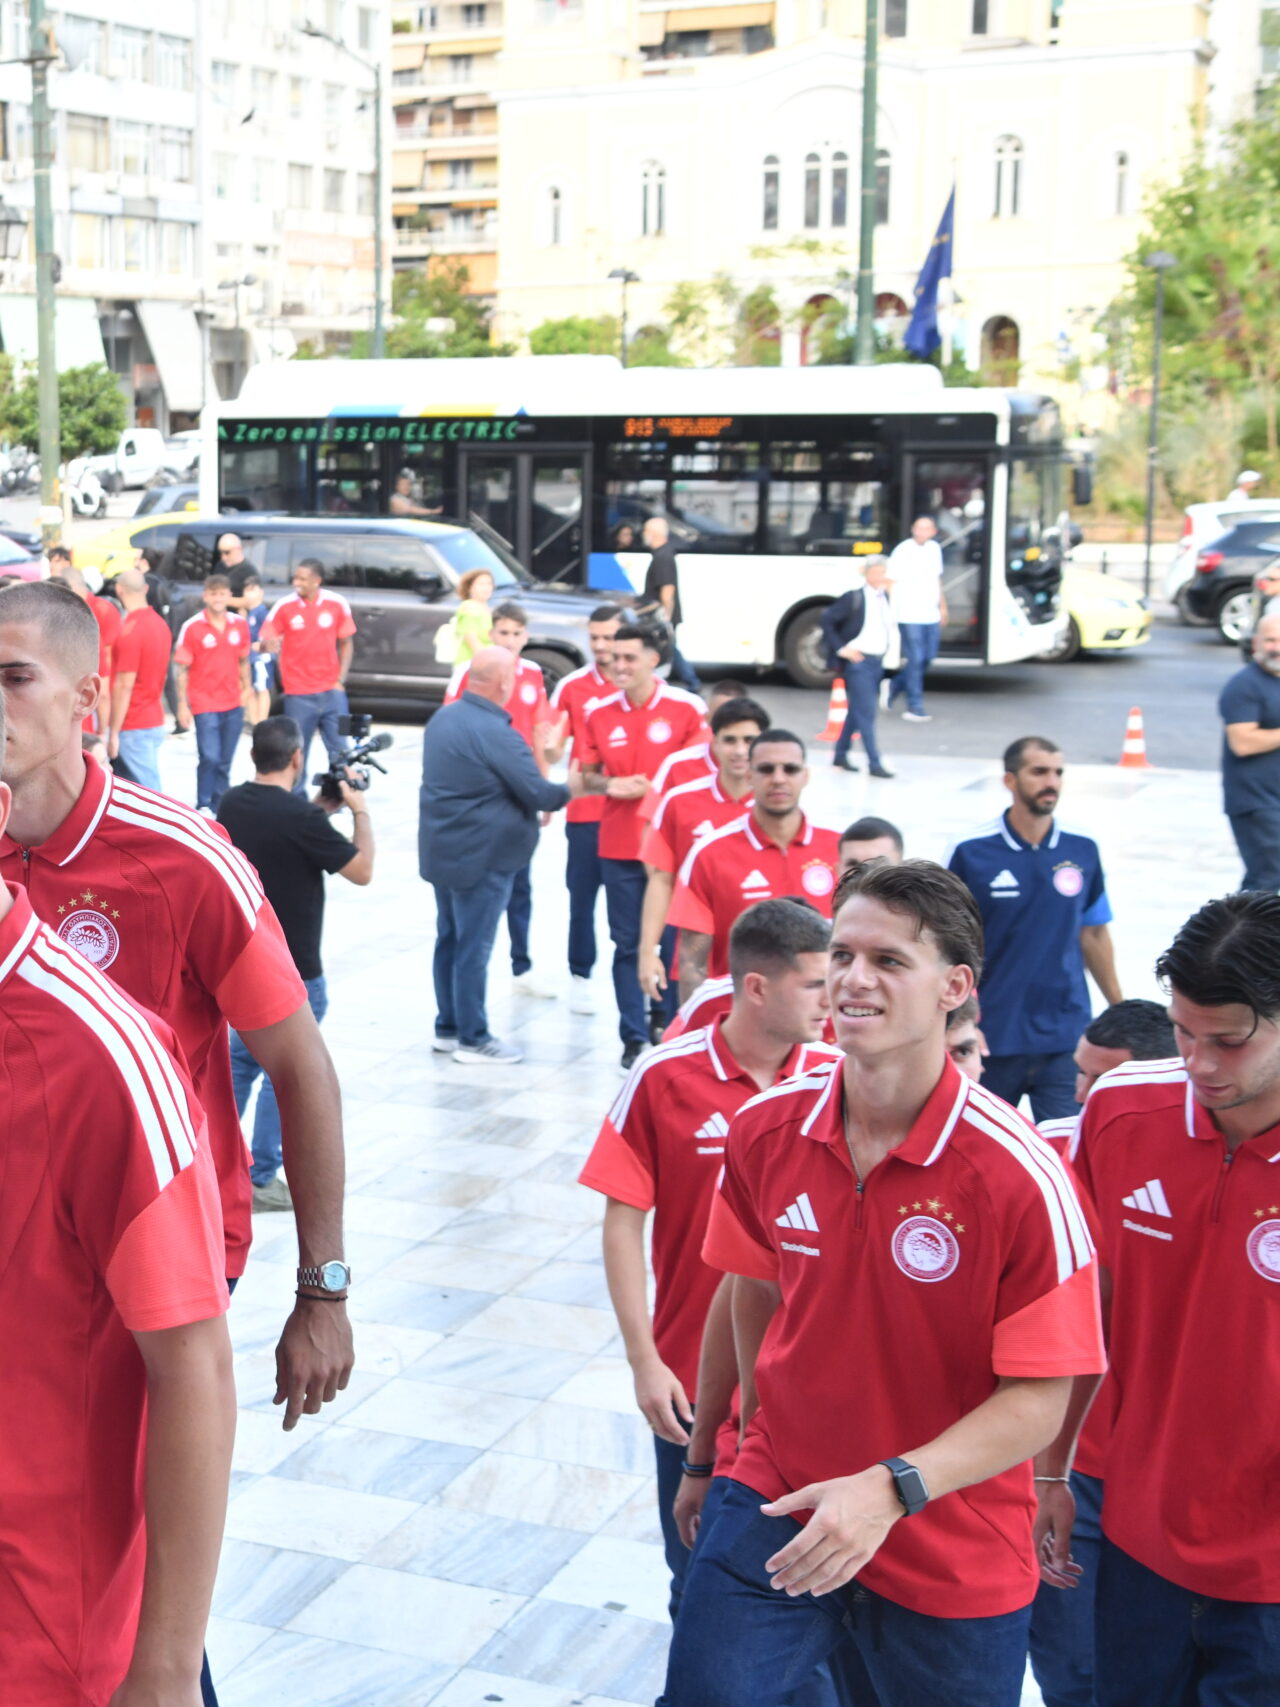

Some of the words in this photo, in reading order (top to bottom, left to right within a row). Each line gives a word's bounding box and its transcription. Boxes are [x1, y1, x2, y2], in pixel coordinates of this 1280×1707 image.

[233, 423, 287, 441] Zero
[291, 421, 402, 441] emission
[403, 419, 521, 440] ELECTRIC
